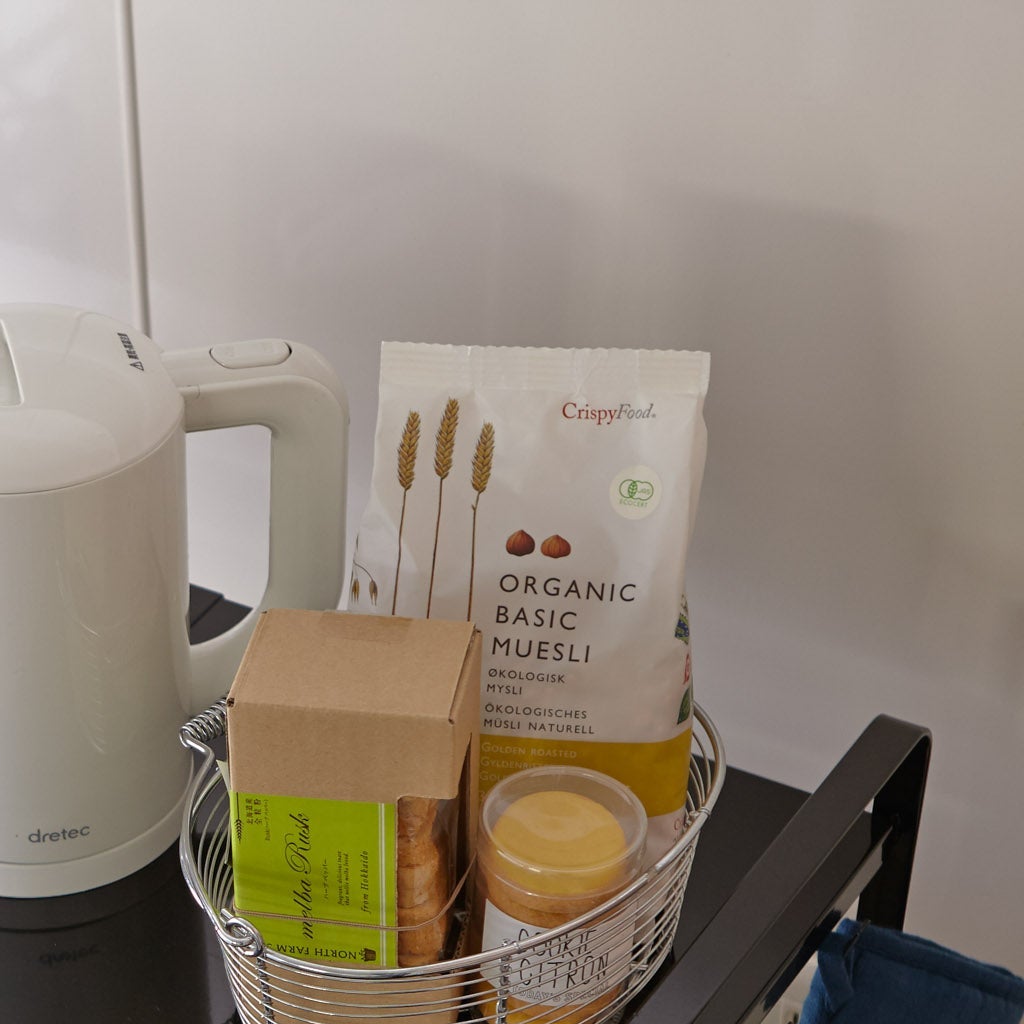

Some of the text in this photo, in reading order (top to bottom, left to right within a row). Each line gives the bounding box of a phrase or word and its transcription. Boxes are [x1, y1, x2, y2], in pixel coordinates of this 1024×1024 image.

[499, 573, 637, 603] ORGANIC
[495, 605, 578, 631] BASIC
[491, 637, 591, 664] MUESLI
[487, 667, 566, 685] ØKOLOGISK
[486, 683, 523, 696] MYSLI
[484, 702, 588, 720] ÖKOLOGISCHES
[483, 717, 595, 735] MÜSLI NATURELL
[28, 825, 91, 844] dretec
[283, 813, 315, 940] melba Rusk
[359, 850, 371, 914] from Hokkaido
[276, 944, 309, 957] FARM
[314, 948, 357, 960] NORTH
[520, 952, 609, 989] CITRON
